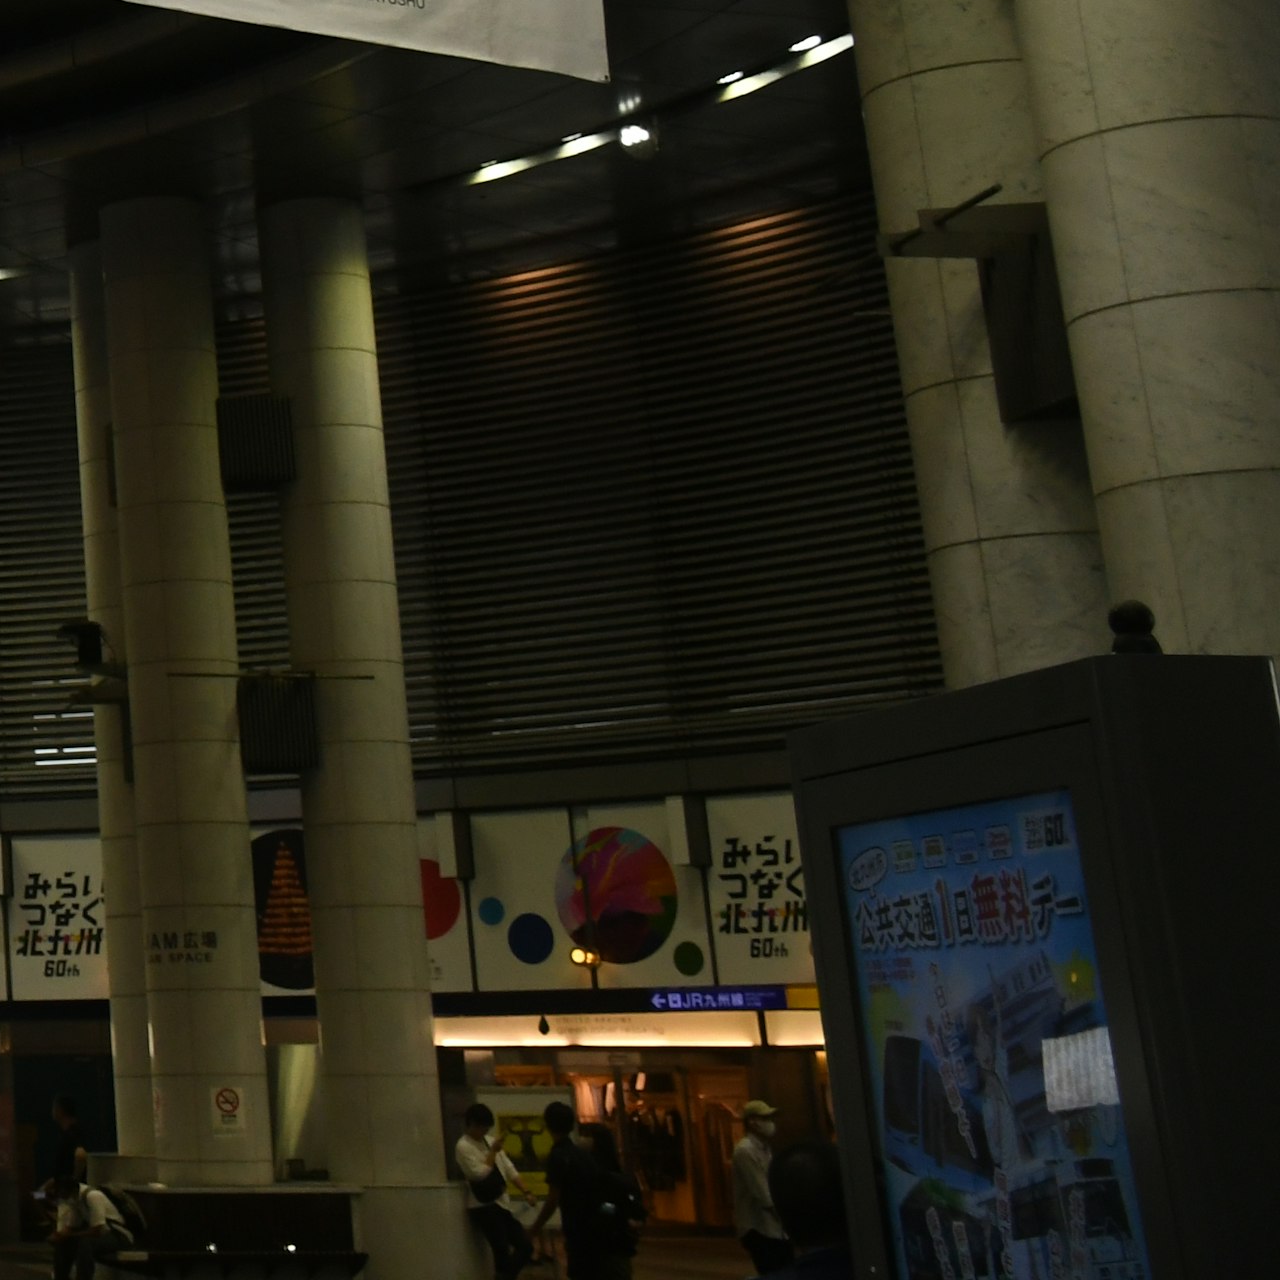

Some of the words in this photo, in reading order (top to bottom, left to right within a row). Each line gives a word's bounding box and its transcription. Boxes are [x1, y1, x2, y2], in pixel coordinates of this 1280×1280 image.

[17, 928, 103, 956] 北九州
[750, 938, 788, 958] 60th
[44, 960, 80, 977] 60th
